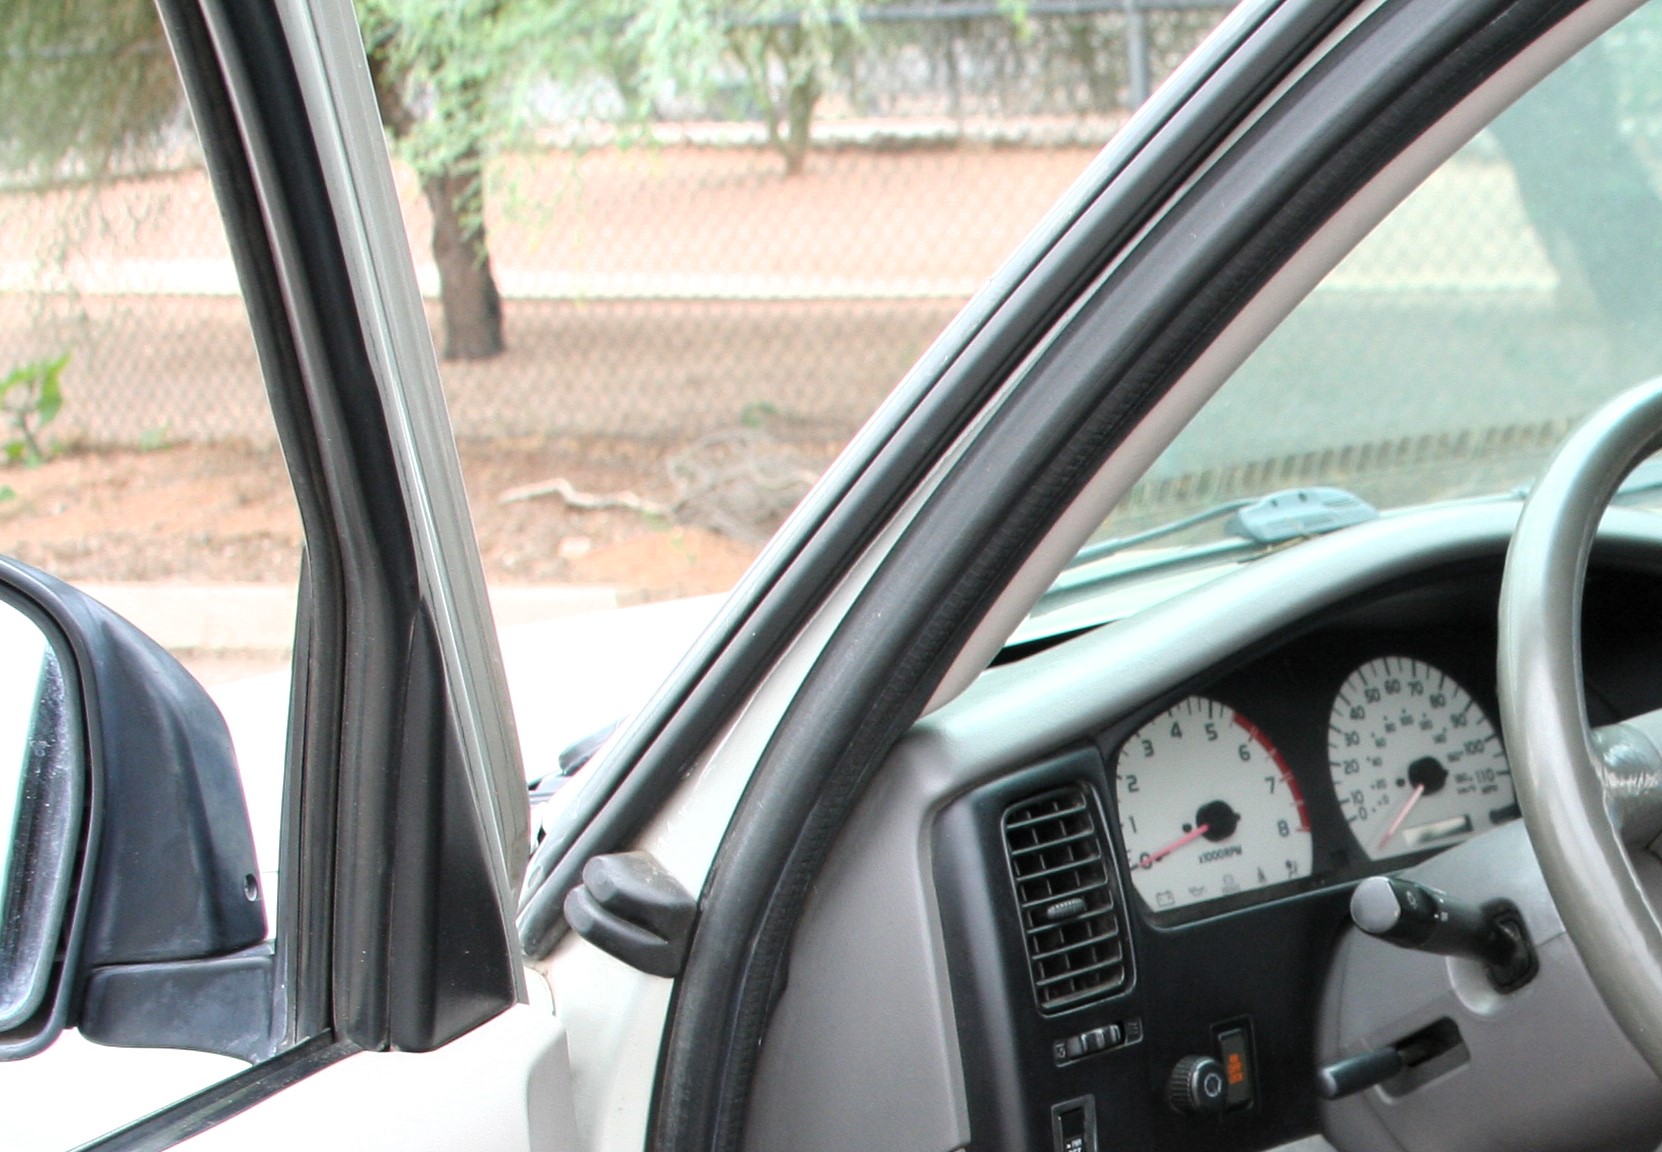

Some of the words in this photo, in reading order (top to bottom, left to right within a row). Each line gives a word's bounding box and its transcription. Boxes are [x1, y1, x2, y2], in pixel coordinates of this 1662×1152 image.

[1385, 679, 1401, 694] 60
[1408, 681, 1424, 696] 70
[1365, 688, 1381, 703] 50
[1350, 705, 1365, 720] 40
[1169, 722, 1183, 739] 4
[1204, 722, 1218, 741] 5
[1345, 731, 1360, 747] 30
[1464, 739, 1485, 755] 100
[1141, 738, 1155, 758] 3
[1238, 744, 1251, 762] 6
[1344, 759, 1360, 775] 20
[1126, 774, 1140, 793] 2
[1476, 768, 1496, 783] 110
[1264, 776, 1276, 794] 7
[1351, 790, 1364, 806] 10
[1359, 806, 1368, 821] 0
[1129, 815, 1138, 834] 1
[1276, 818, 1290, 837] 8
[1139, 851, 1153, 870] 0
